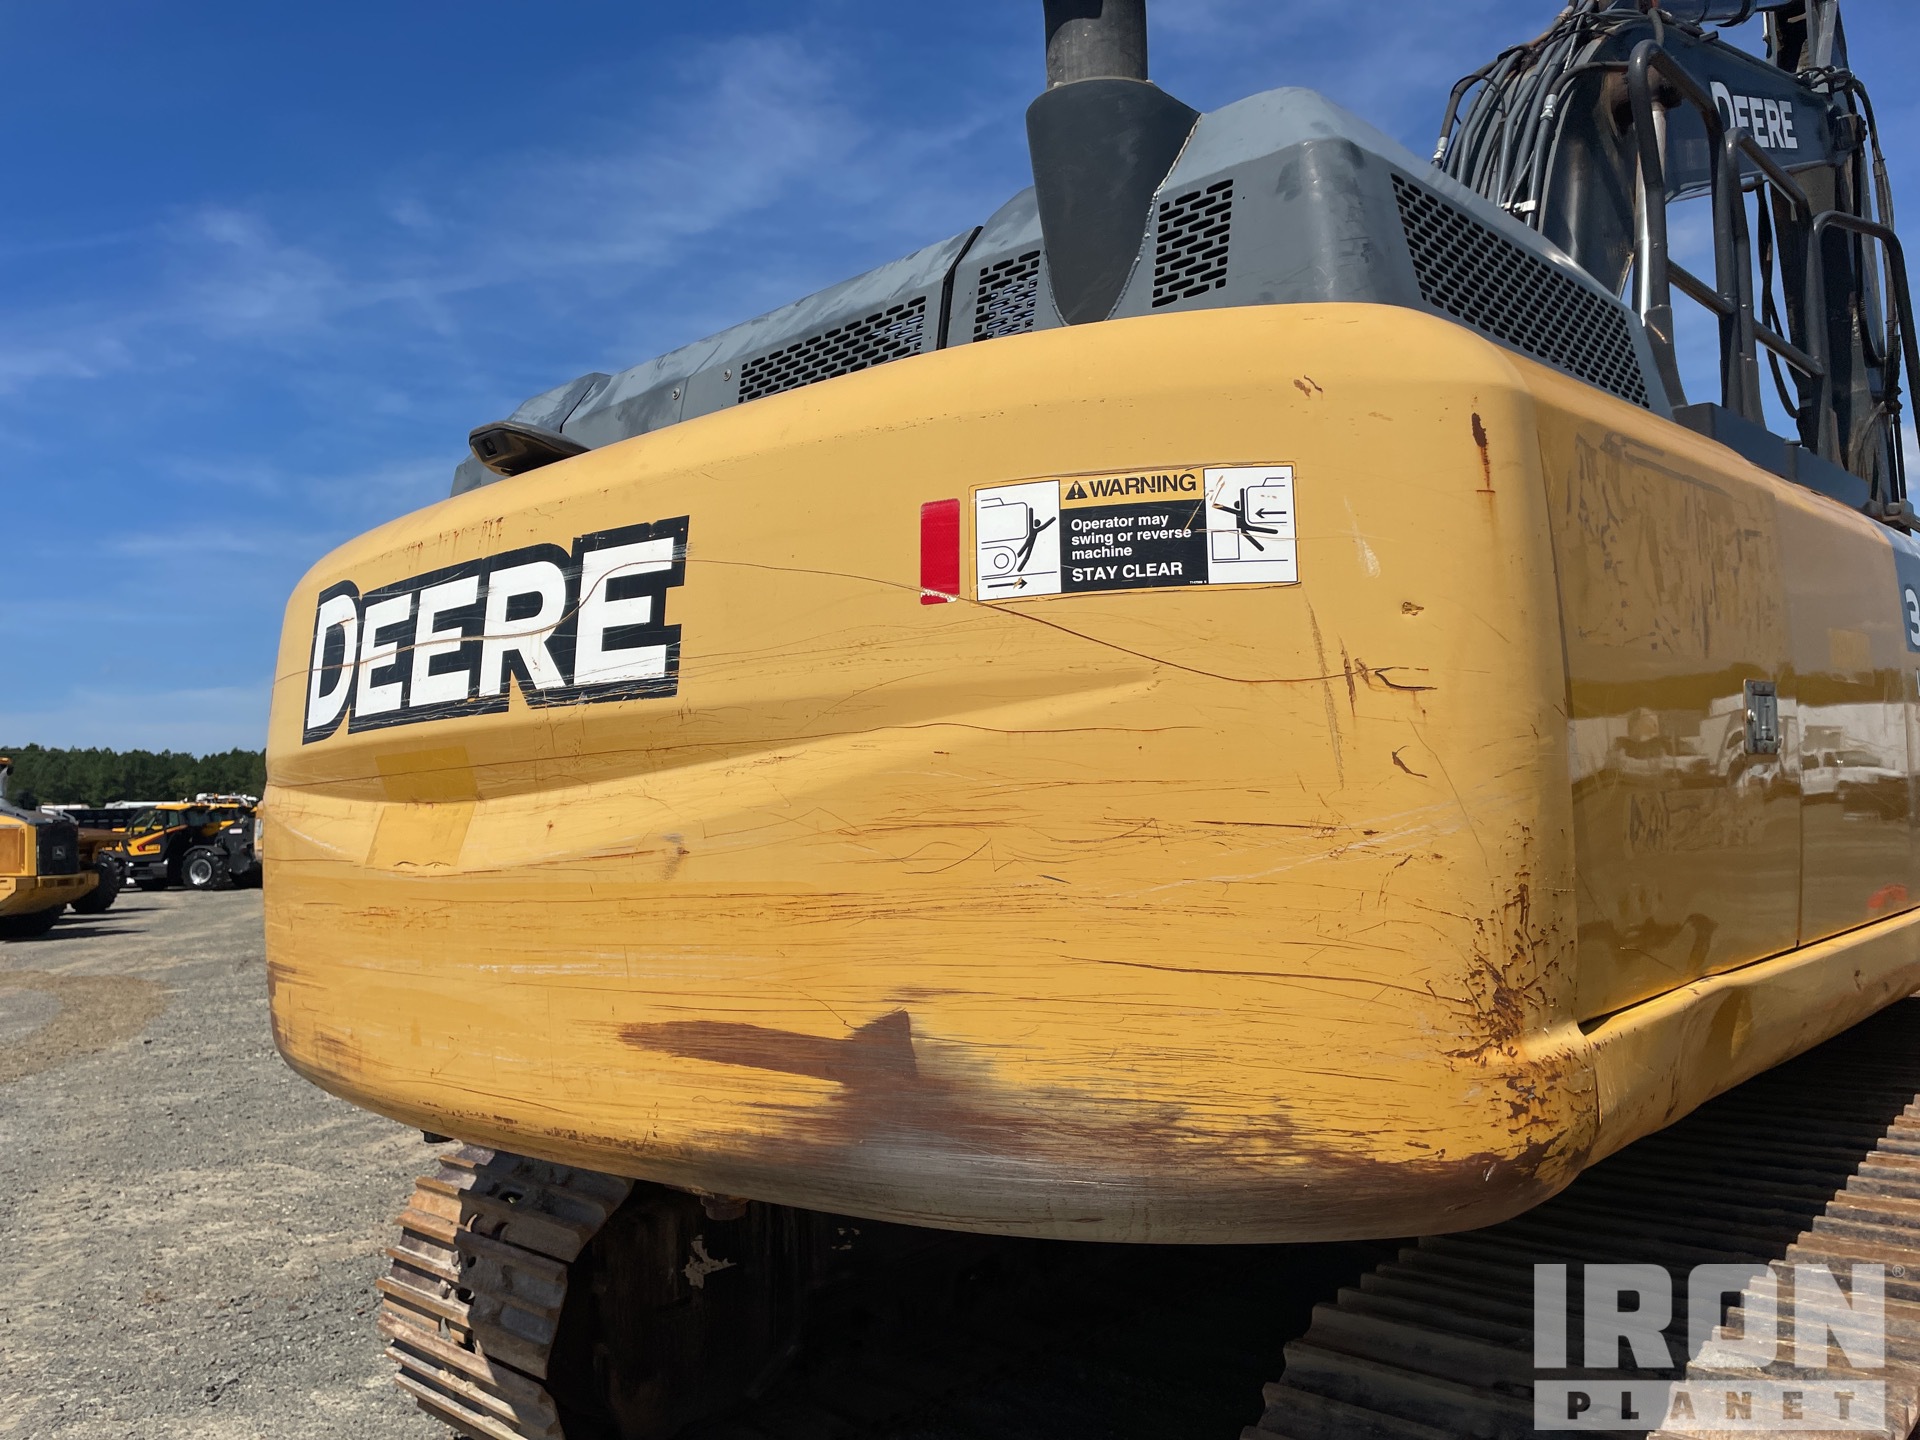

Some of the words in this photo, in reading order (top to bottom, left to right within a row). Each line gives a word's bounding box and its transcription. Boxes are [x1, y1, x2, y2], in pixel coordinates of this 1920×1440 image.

[1710, 81, 1798, 149] DEERE
[1088, 473, 1197, 498] WARNING
[1070, 516, 1135, 533] Operator
[1138, 514, 1169, 527] may
[1071, 532, 1114, 546] swing
[1117, 531, 1134, 542] or
[1137, 528, 1192, 541] reverse
[1071, 545, 1133, 561] machine
[1071, 565, 1119, 582] STAY
[1122, 561, 1183, 578] CLEAR
[1904, 587, 1920, 647] 3
[306, 536, 675, 730] DEERE
